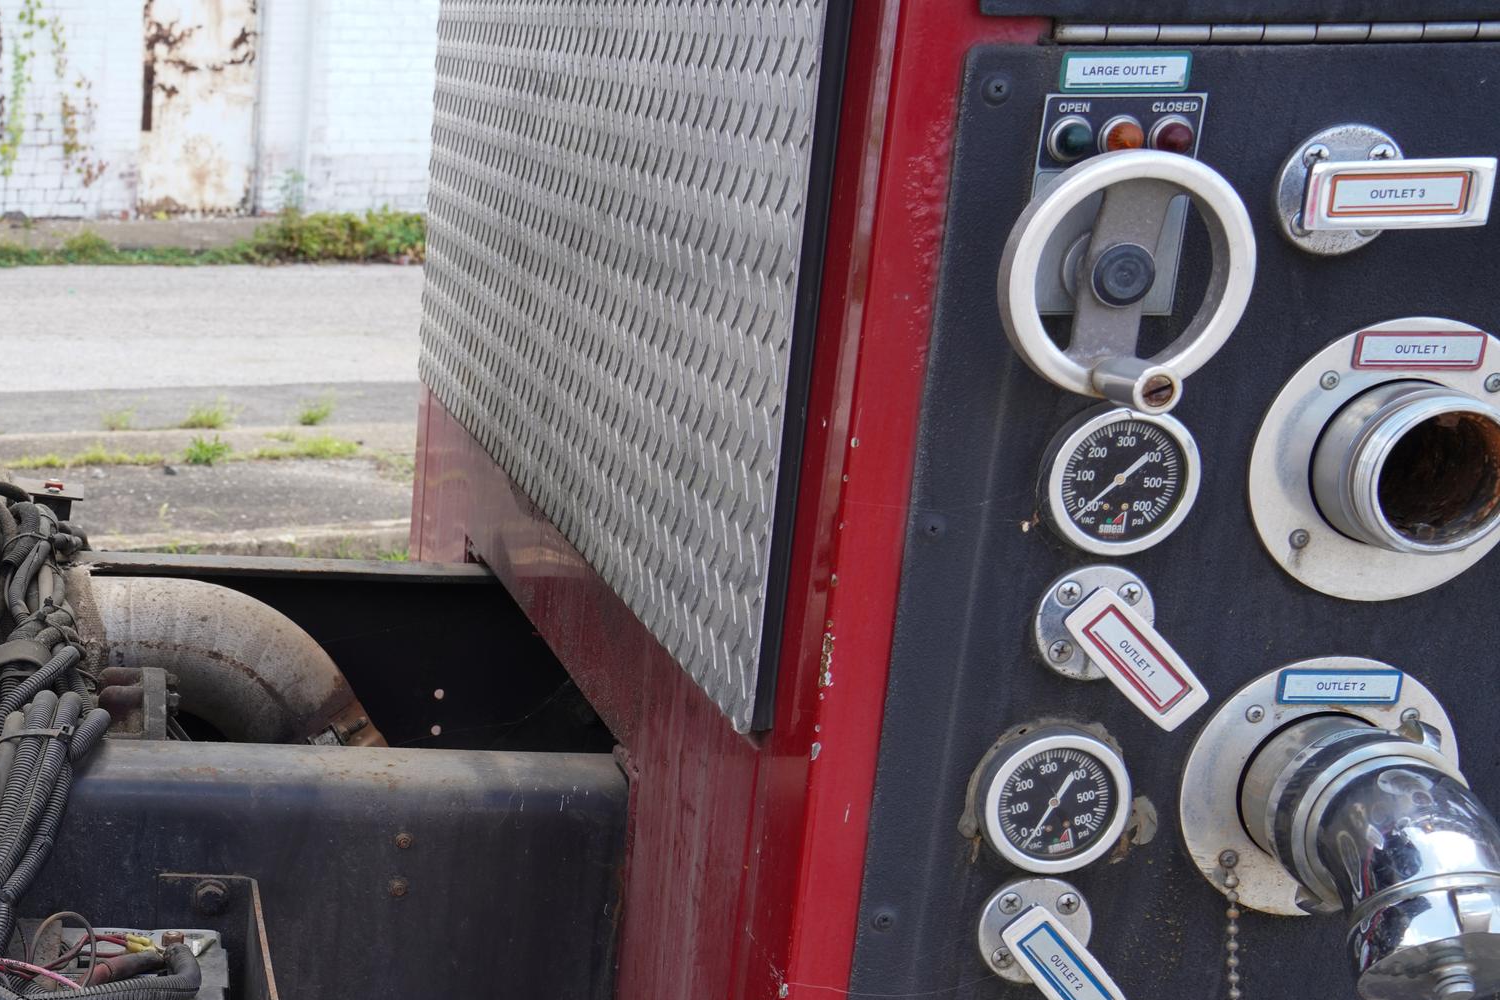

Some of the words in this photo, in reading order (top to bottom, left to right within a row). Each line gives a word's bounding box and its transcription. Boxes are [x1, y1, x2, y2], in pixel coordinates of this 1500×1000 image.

[1082, 66, 1120, 76] LARGE
[1122, 65, 1167, 76] OUTLET
[1058, 102, 1090, 113] OPEN
[1152, 102, 1198, 113] CLOSED
[1370, 188, 1417, 199] OUTLET
[1418, 188, 1426, 199] 3
[1395, 344, 1439, 354] OUTLET
[1441, 345, 1447, 354] 1
[1117, 436, 1136, 447] 300
[1088, 447, 1107, 458] 200
[1076, 470, 1095, 481] 100
[1143, 477, 1163, 488] 500
[1078, 497, 1085, 508] 0
[1133, 501, 1152, 512] 600
[1081, 516, 1095, 524] VAC
[1131, 517, 1144, 526] psi
[1119, 640, 1151, 671] OUTLET
[1148, 670, 1156, 678] 1
[1316, 682, 1357, 691] OUTLET
[1359, 682, 1366, 691] 2
[1040, 762, 1058, 775] 300
[1070, 769, 1087, 781] 00
[1015, 779, 1034, 792] 200
[1077, 790, 1095, 803] 500
[1011, 802, 1029, 815] 100
[1074, 813, 1092, 826] 600
[1020, 827, 1028, 837] 0
[1078, 829, 1090, 840] psi
[1028, 841, 1042, 850] VAC
[1050, 954, 1079, 984] OUTLET
[1075, 983, 1084, 991] 2
